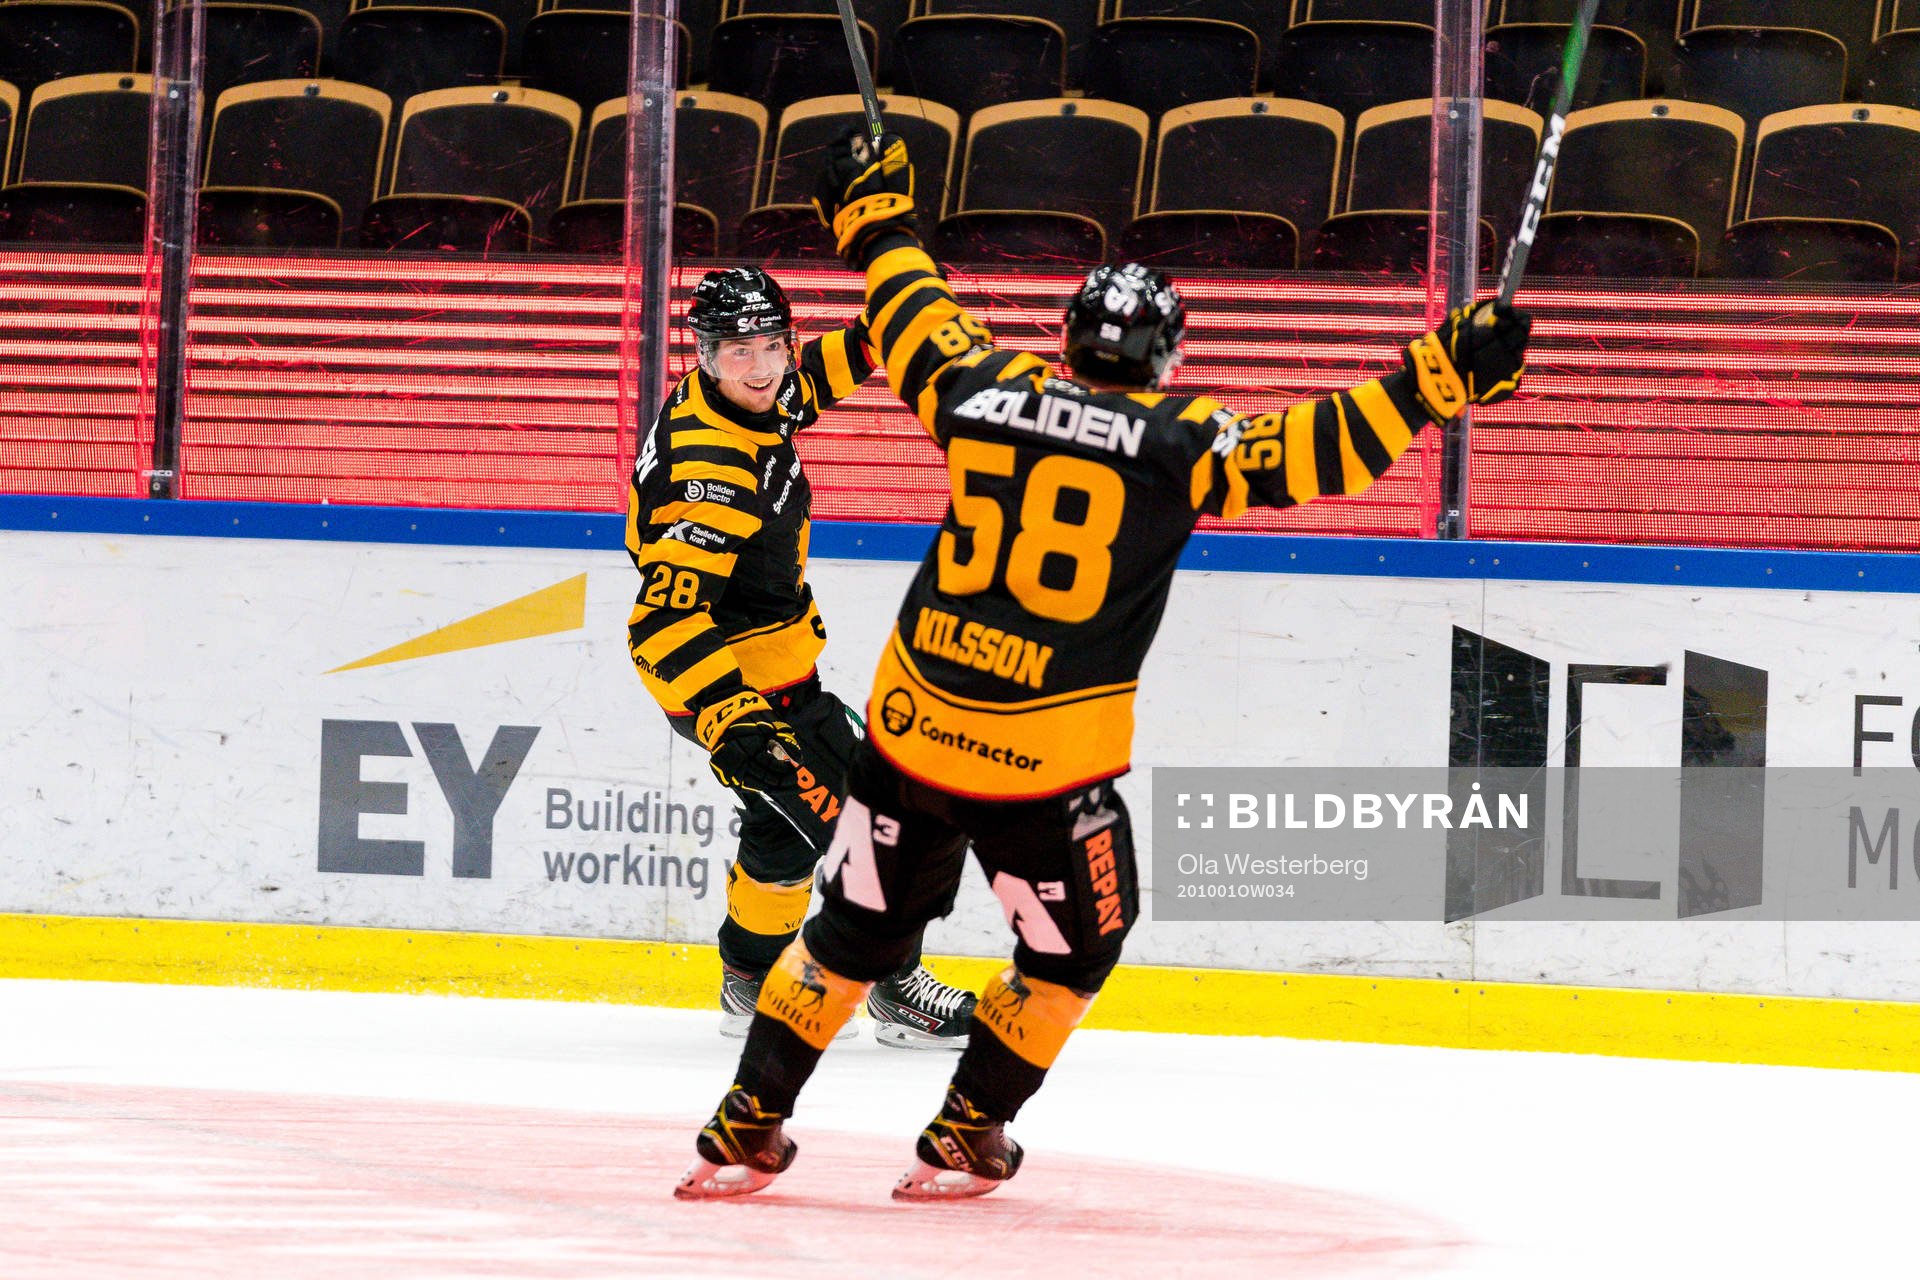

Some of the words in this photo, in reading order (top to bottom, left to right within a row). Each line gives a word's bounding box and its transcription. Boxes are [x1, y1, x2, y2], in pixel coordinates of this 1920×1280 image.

[737, 315, 760, 333] SK
[952, 388, 1147, 459] BOLIDEN
[688, 534, 708, 547] Kraft
[937, 436, 1126, 625] 58
[643, 564, 700, 610] 28
[912, 607, 1055, 690] NILSSON
[702, 696, 759, 744] CCM
[919, 717, 1043, 774] Contractor
[1852, 694, 1920, 777] F
[317, 718, 542, 880] EY
[545, 787, 715, 848] Building
[543, 843, 709, 900] working
[1084, 828, 1125, 937] REPAY
[897, 1007, 931, 1028] CCM
